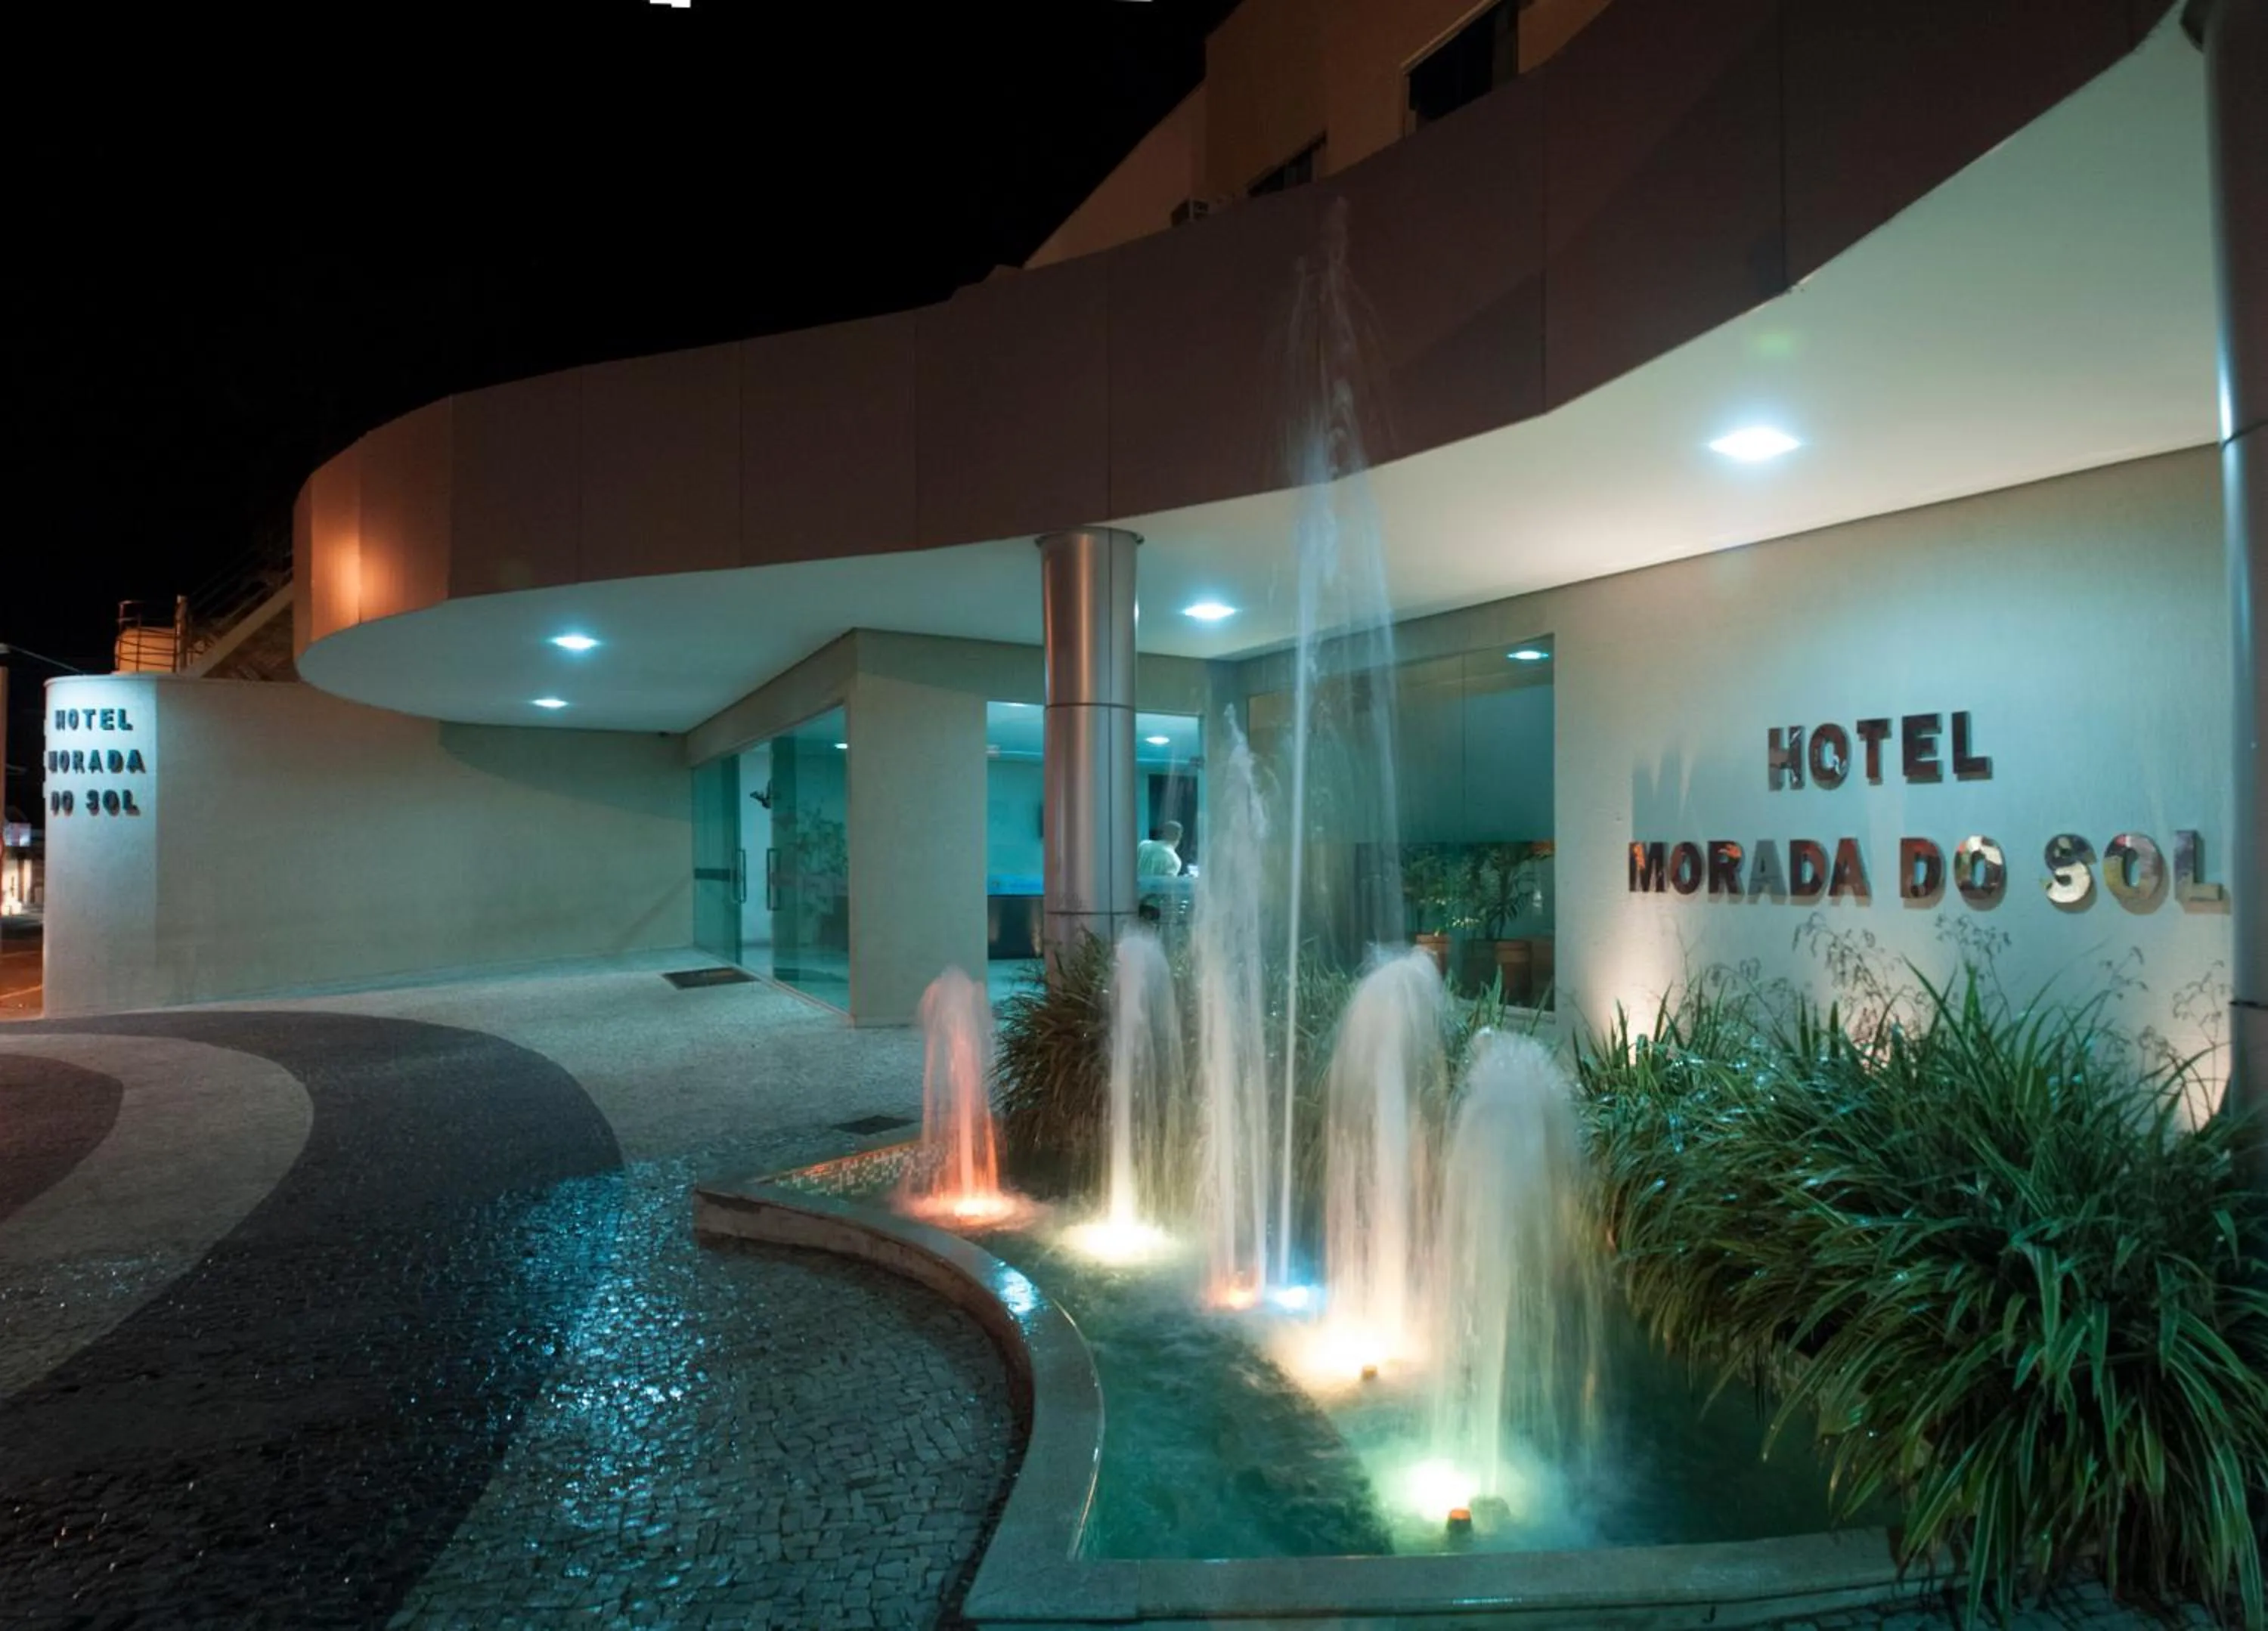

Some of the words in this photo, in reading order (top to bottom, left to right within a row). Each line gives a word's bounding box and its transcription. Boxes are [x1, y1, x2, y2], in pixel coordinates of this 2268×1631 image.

[55, 709, 133, 730] HOTEL
[1768, 711, 1992, 791] HOTEL
[51, 791, 73, 816] DO
[86, 789, 141, 816] SOL
[1628, 837, 1869, 904] MORADA
[1900, 834, 2006, 908] DO
[2043, 831, 2226, 908] SOL
